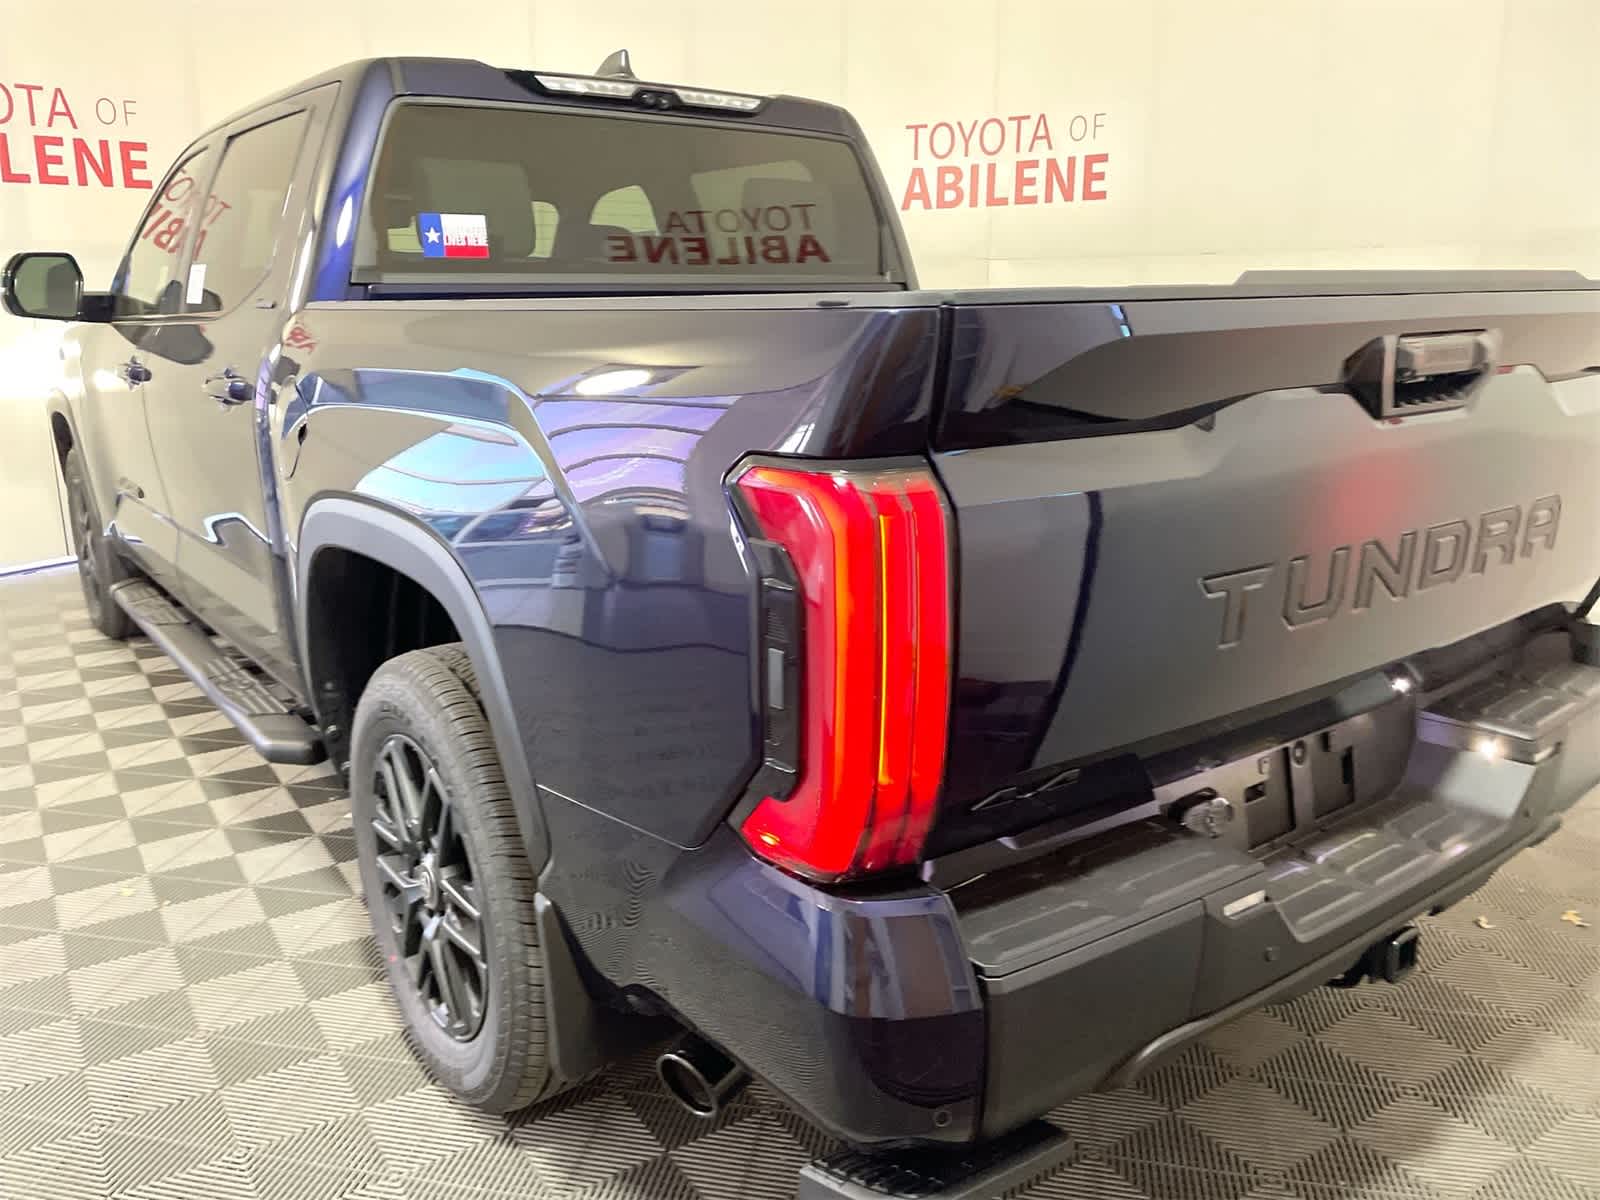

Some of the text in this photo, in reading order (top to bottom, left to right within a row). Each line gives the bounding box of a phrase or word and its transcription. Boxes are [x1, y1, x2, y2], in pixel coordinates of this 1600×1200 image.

[95, 97, 137, 126] OF
[905, 112, 1107, 161] TOYOTA OF
[901, 153, 1109, 211] ABILENE
[1198, 493, 1561, 650] TUNDRA
